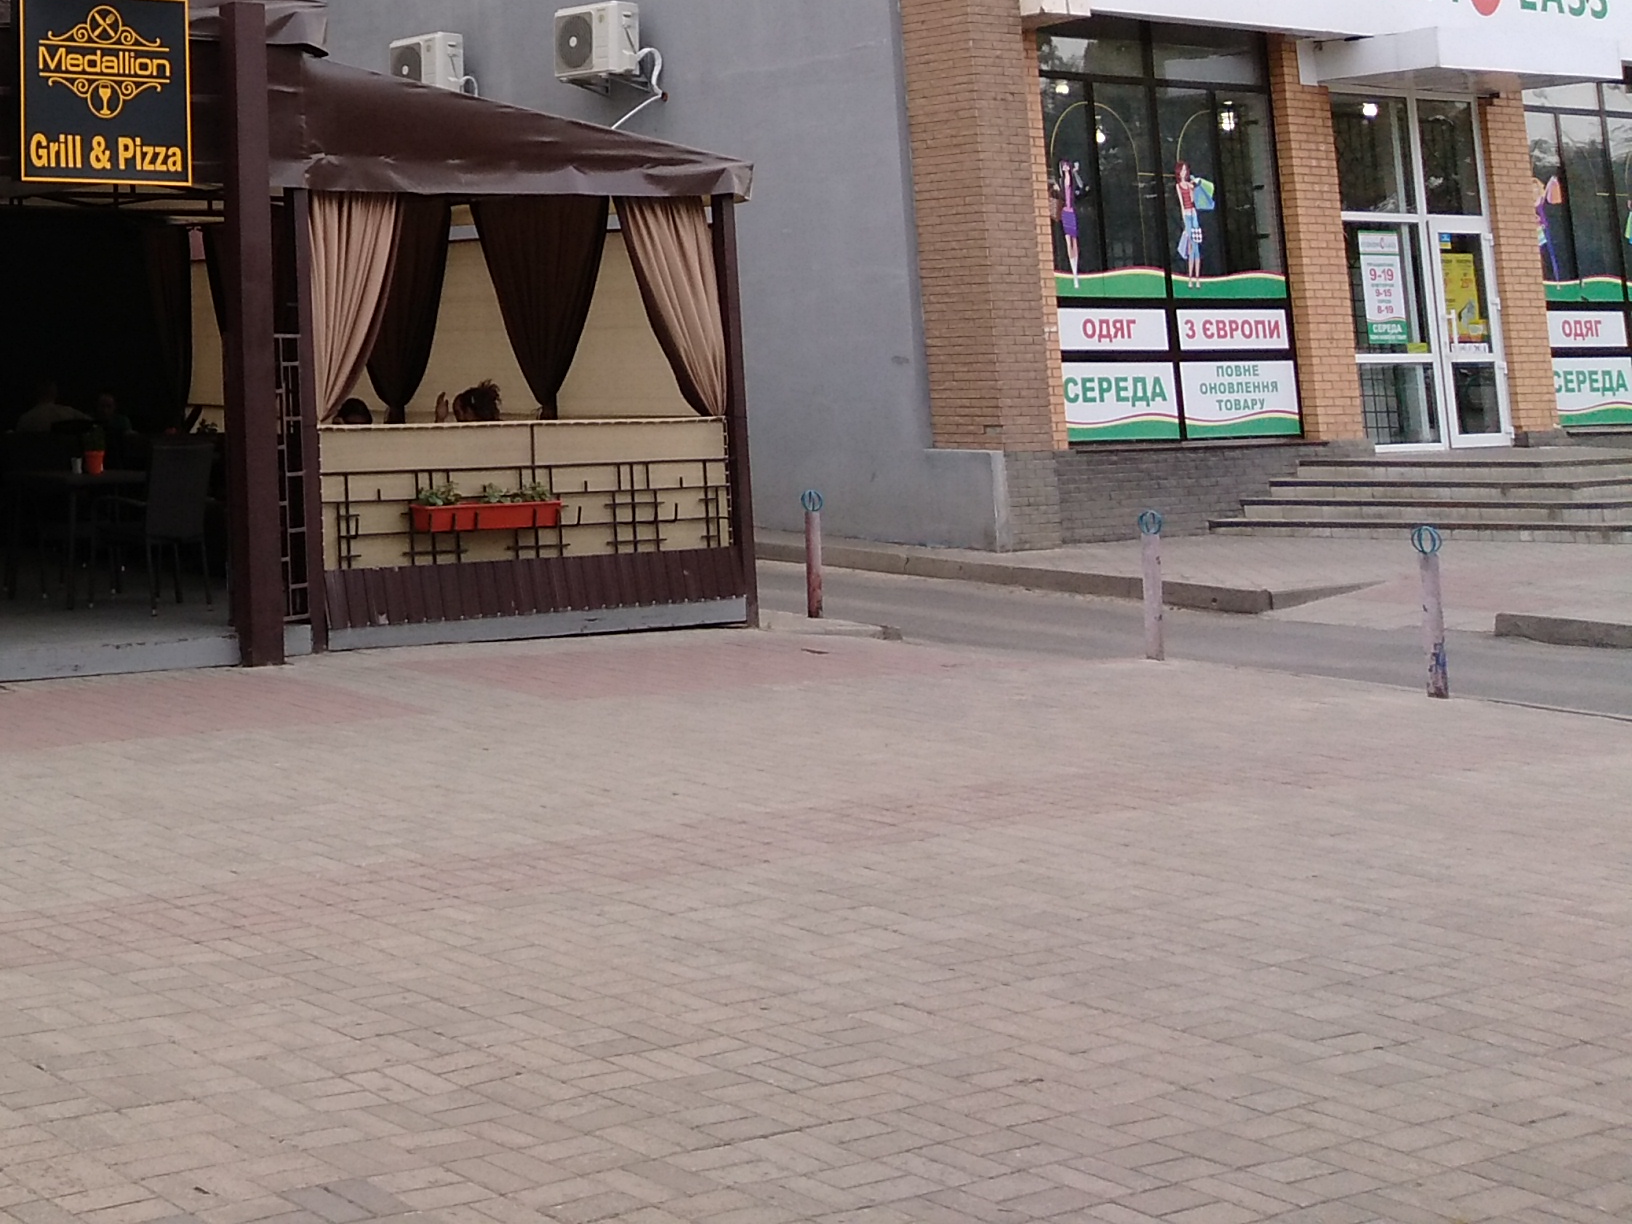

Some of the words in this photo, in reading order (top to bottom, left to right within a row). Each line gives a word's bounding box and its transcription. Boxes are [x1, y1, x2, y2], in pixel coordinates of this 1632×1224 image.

[38, 46, 170, 77] Medallion
[30, 133, 82, 168] Grill
[89, 135, 111, 169] &
[118, 137, 182, 172] Pizza
[1082, 318, 1136, 343] ОДЯГ
[1202, 319, 1281, 340] ЄВРОПИ
[1561, 319, 1602, 341] ОДЯГ
[1216, 364, 1259, 378] ПОВНЕ
[1064, 376, 1168, 407] СЕРЕДА
[1199, 380, 1279, 395] ОНОВЛЕННЯ
[1216, 398, 1265, 412] ТОВАРУ
